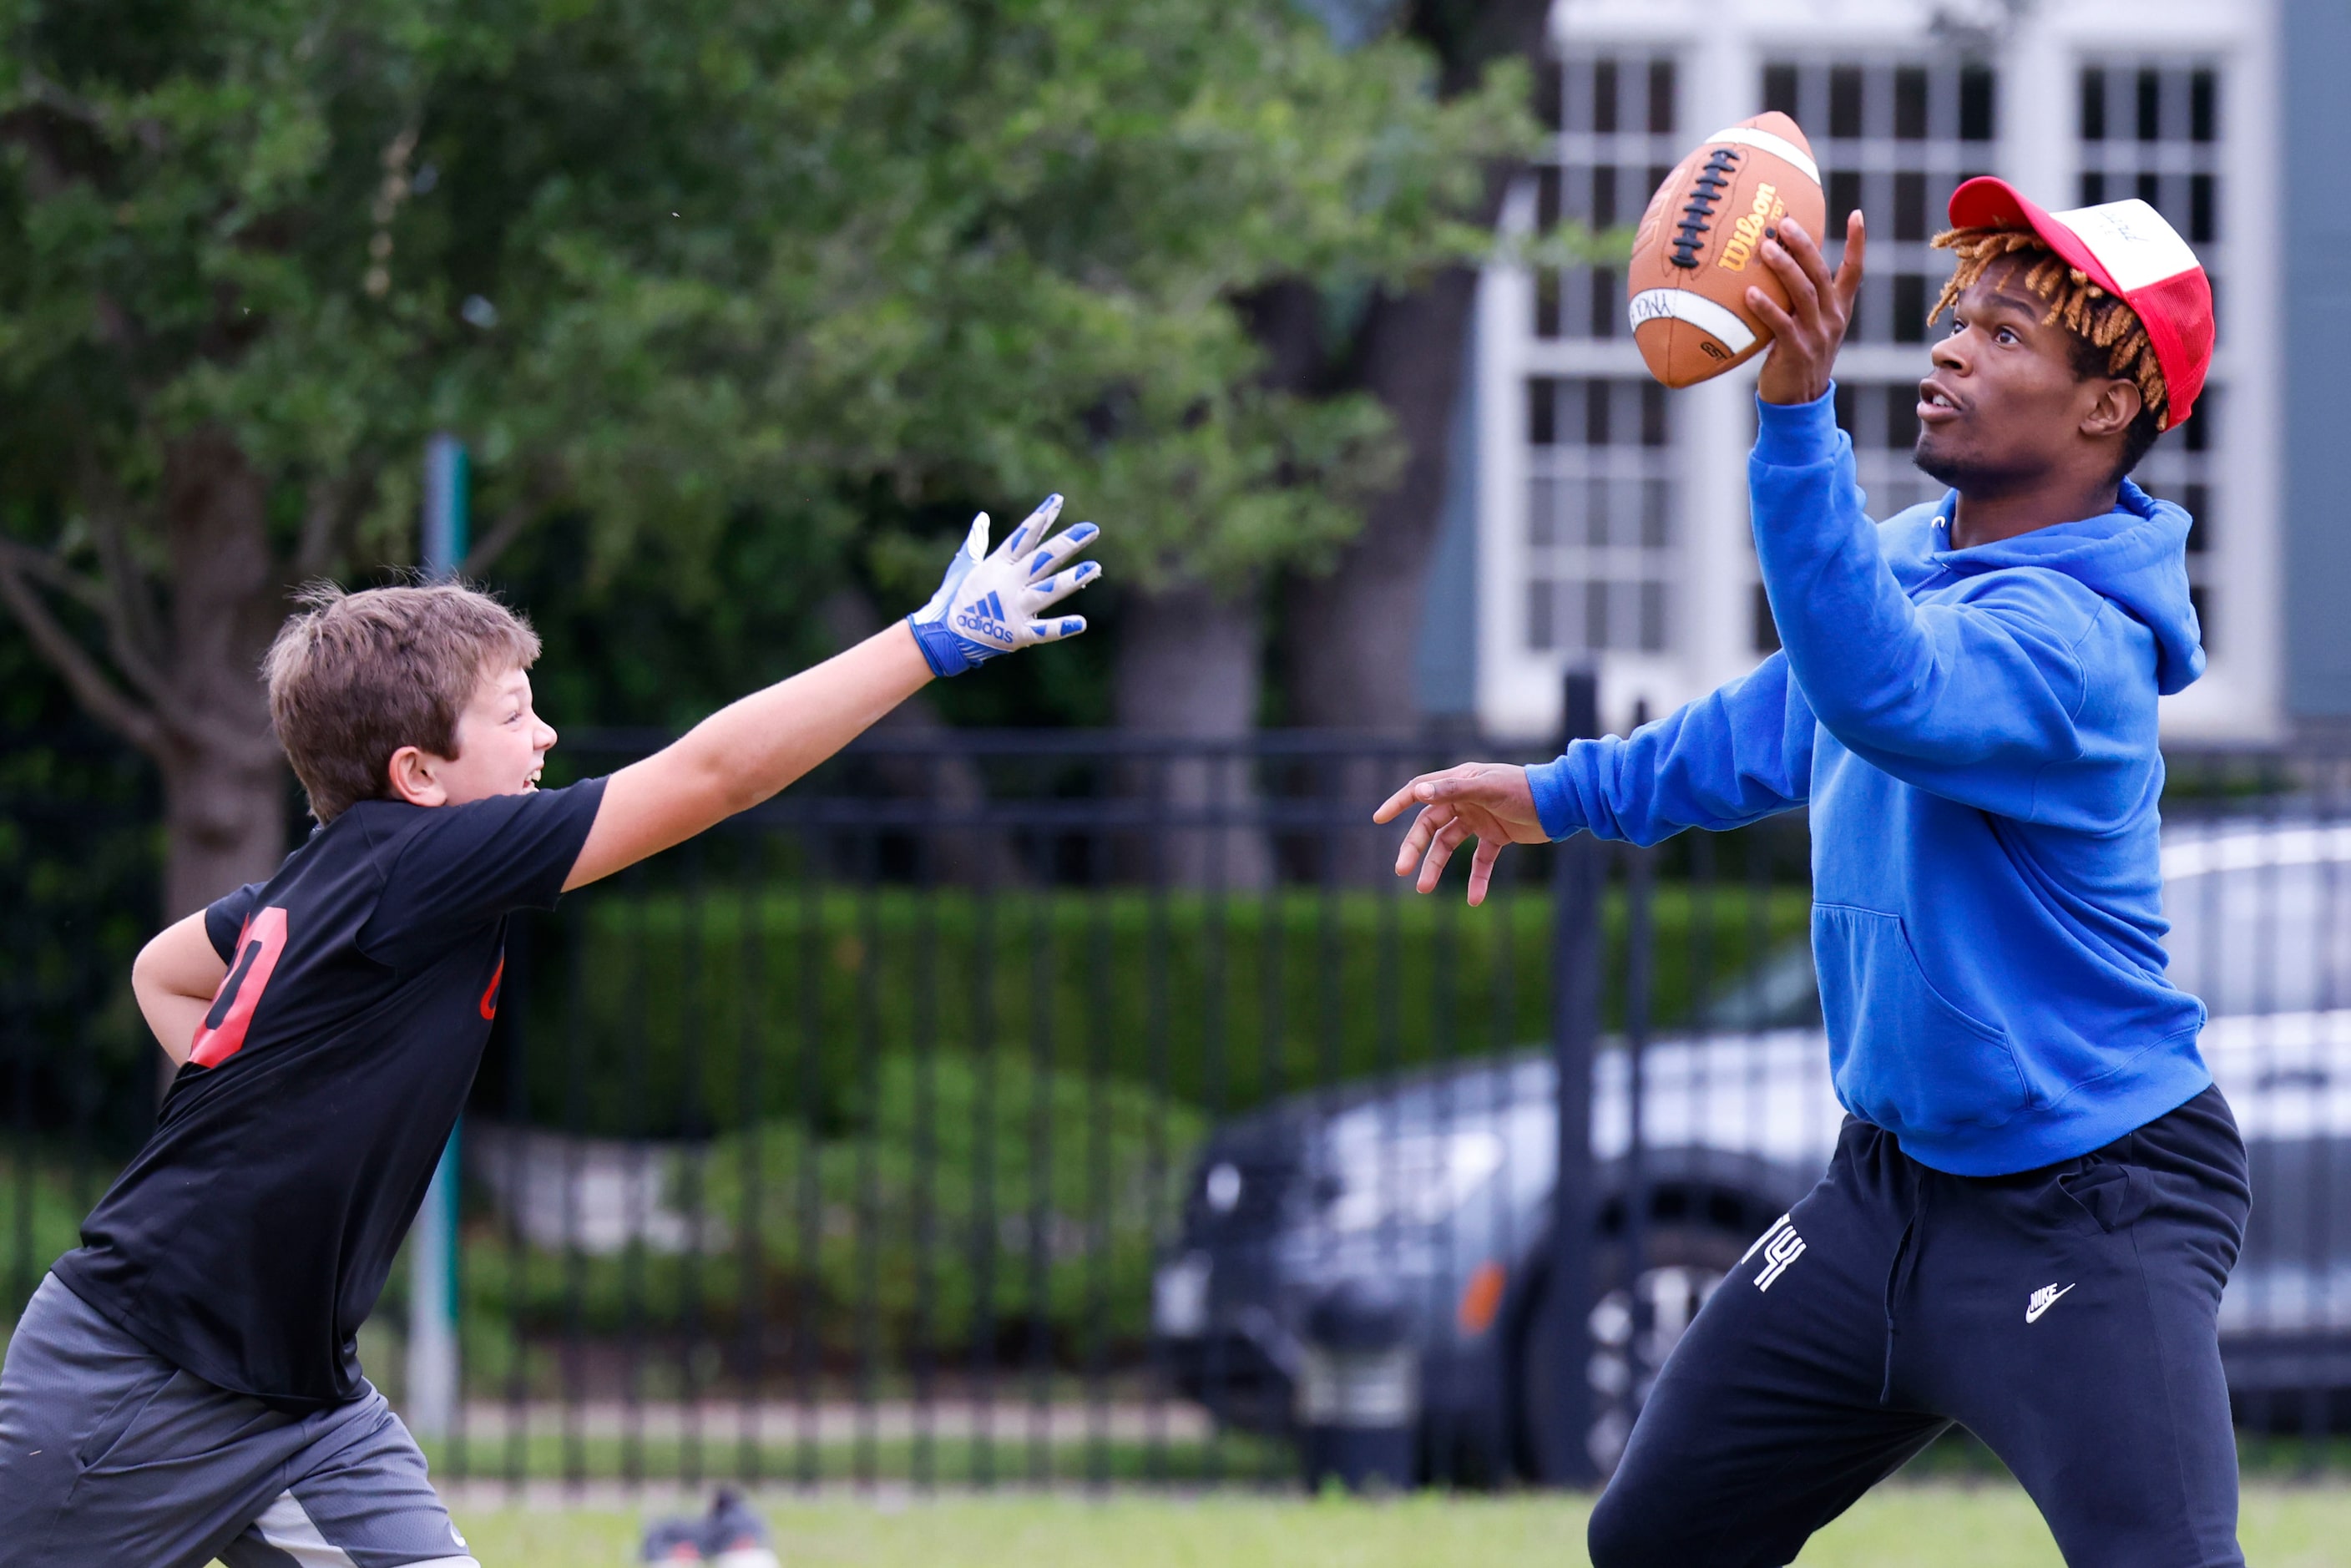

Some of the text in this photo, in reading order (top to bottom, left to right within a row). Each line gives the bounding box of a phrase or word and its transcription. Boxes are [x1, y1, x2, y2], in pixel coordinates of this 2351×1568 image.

[1718, 182, 1776, 271] Wilson
[957, 614, 1014, 644] adidas
[2030, 1282, 2058, 1312] NIKE
